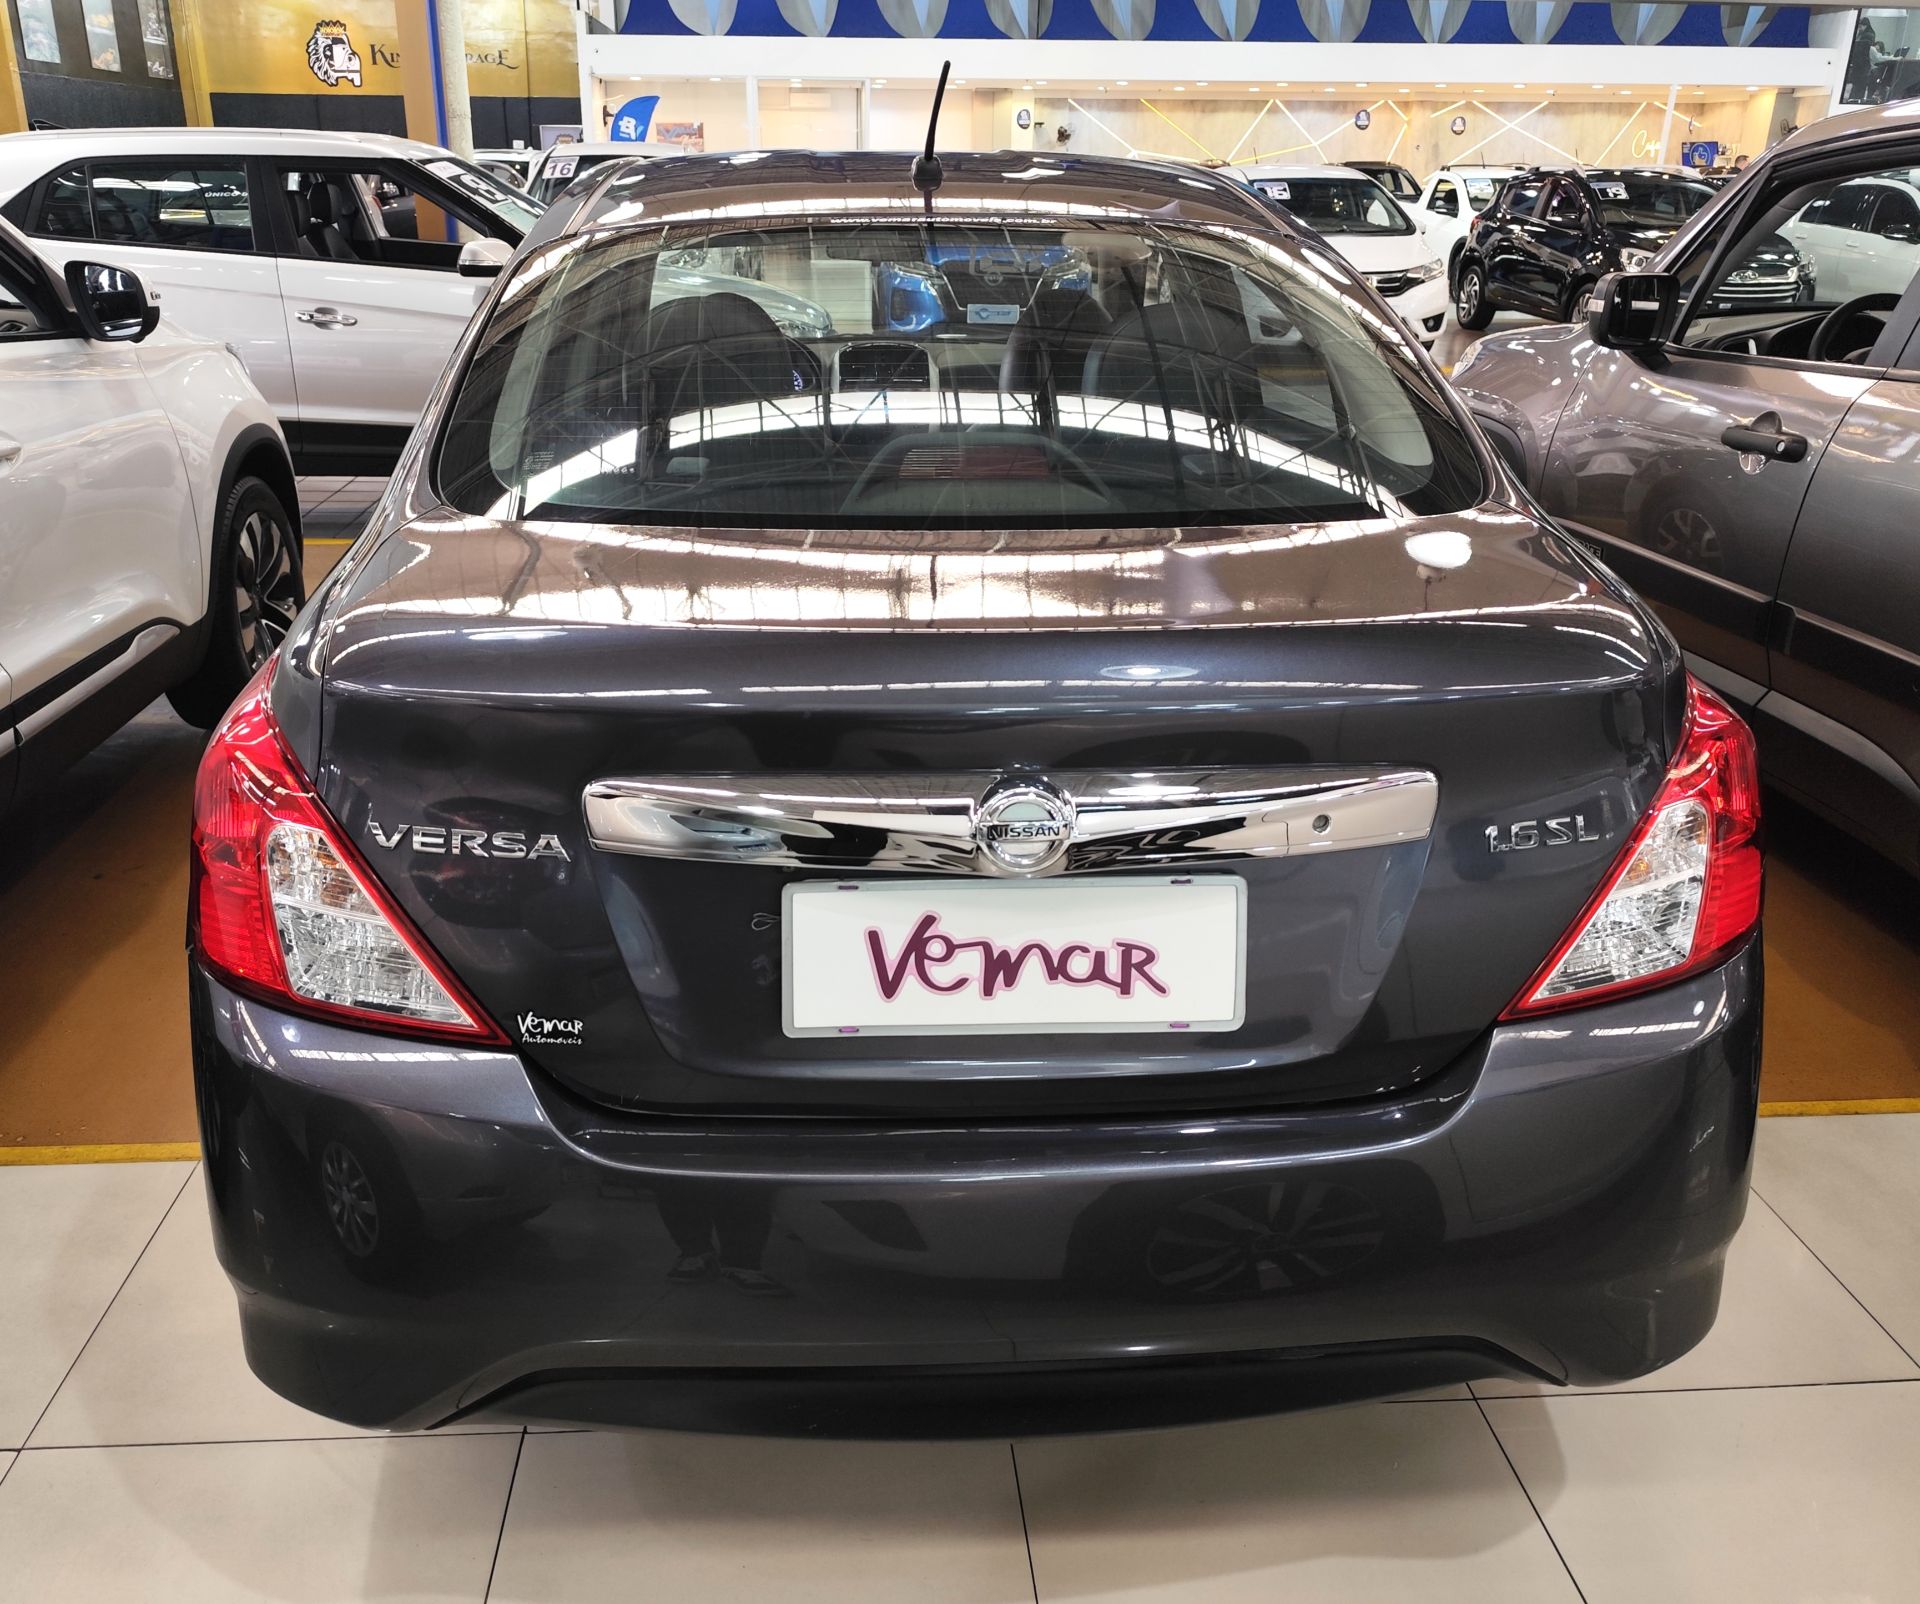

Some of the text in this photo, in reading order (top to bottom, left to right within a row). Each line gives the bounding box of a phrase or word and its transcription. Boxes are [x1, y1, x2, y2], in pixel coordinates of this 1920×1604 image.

[549, 163, 572, 176] 16
[1606, 187, 1627, 199] 19
[987, 825, 1060, 840] NISSAN
[369, 821, 572, 863] VERSA
